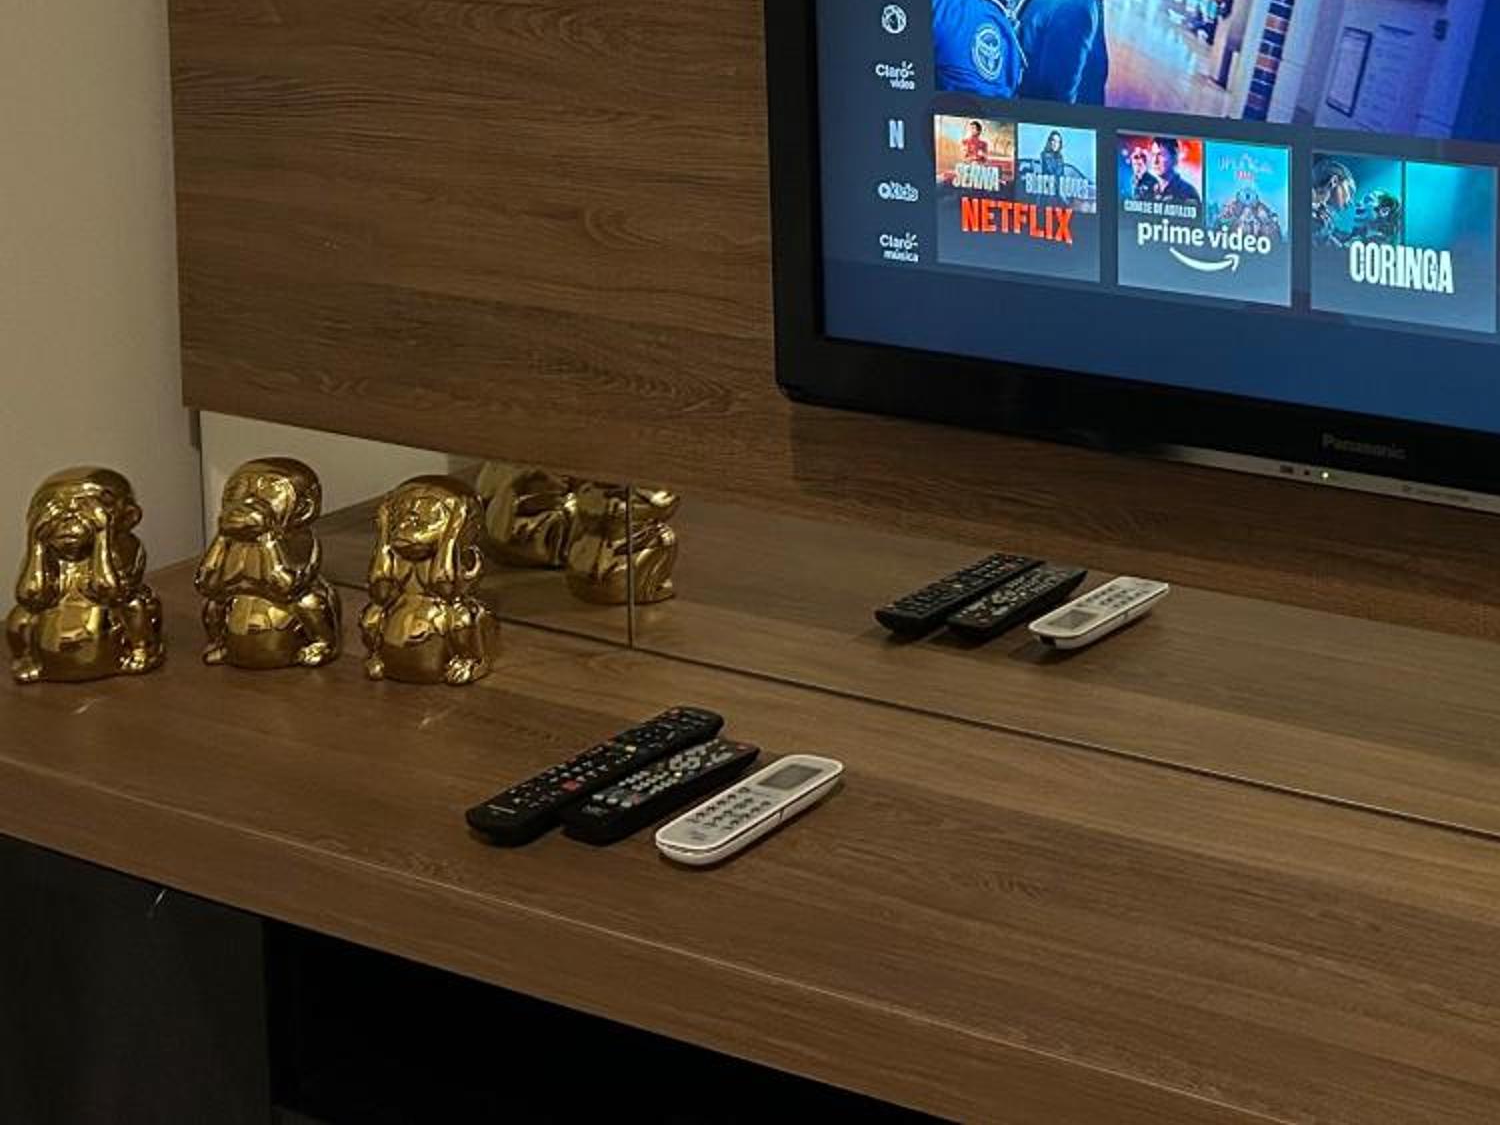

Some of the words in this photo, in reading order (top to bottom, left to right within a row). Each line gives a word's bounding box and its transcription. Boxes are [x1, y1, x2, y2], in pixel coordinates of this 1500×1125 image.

[875, 62, 911, 78] Claro
[960, 196, 1073, 247] NETFLIX
[1137, 218, 1204, 246] prime
[1207, 225, 1271, 254] video
[879, 233, 915, 249] Claro
[1351, 240, 1455, 294] CORINGA
